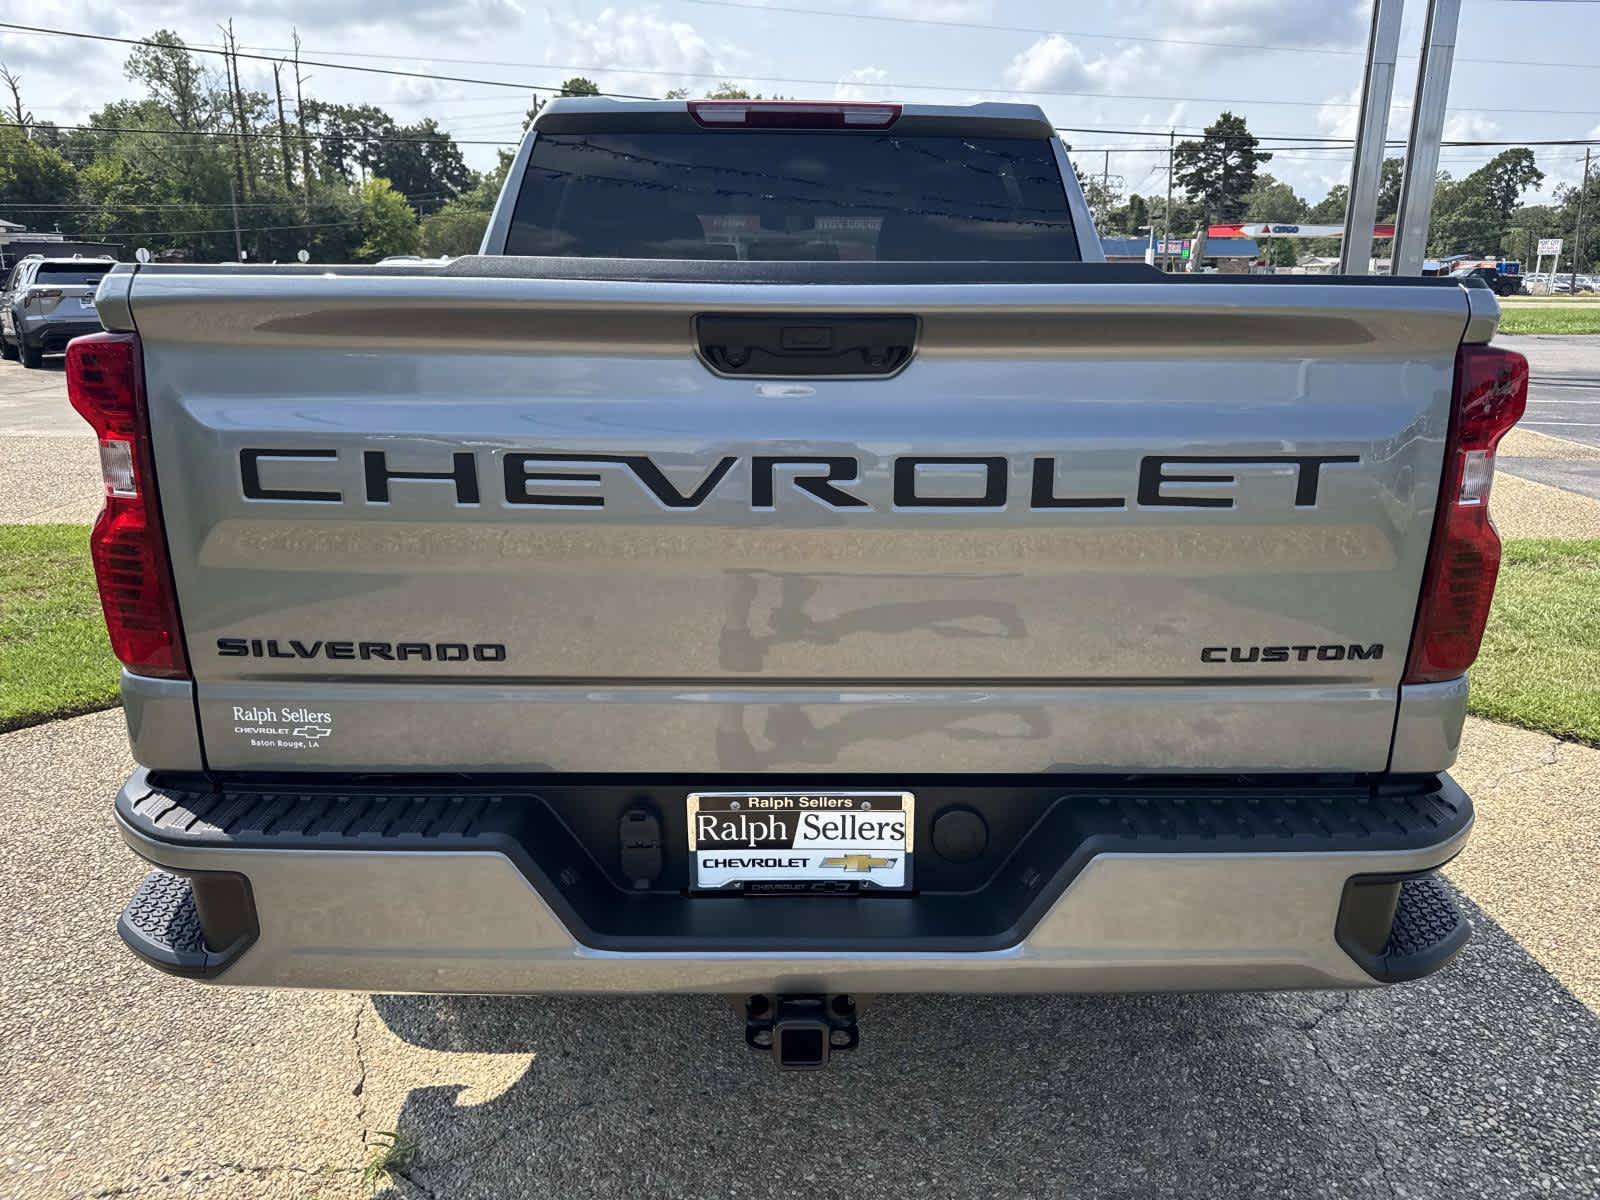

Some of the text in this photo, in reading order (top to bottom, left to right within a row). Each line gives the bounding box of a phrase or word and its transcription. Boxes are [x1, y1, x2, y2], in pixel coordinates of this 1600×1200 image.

[239, 447, 1361, 513] CHEVROLET
[217, 638, 506, 662] SILVERADO
[1201, 644, 1384, 663] CUSTOM
[232, 706, 332, 725] Ralph Sellers
[234, 726, 289, 735] CHEVROLET
[251, 739, 275, 747] Baton
[277, 740, 306, 749] Rouge,
[748, 797, 853, 809] Ralph Sellers
[697, 814, 905, 847] Ralph Sellers
[702, 858, 810, 869] CHEVROLET
